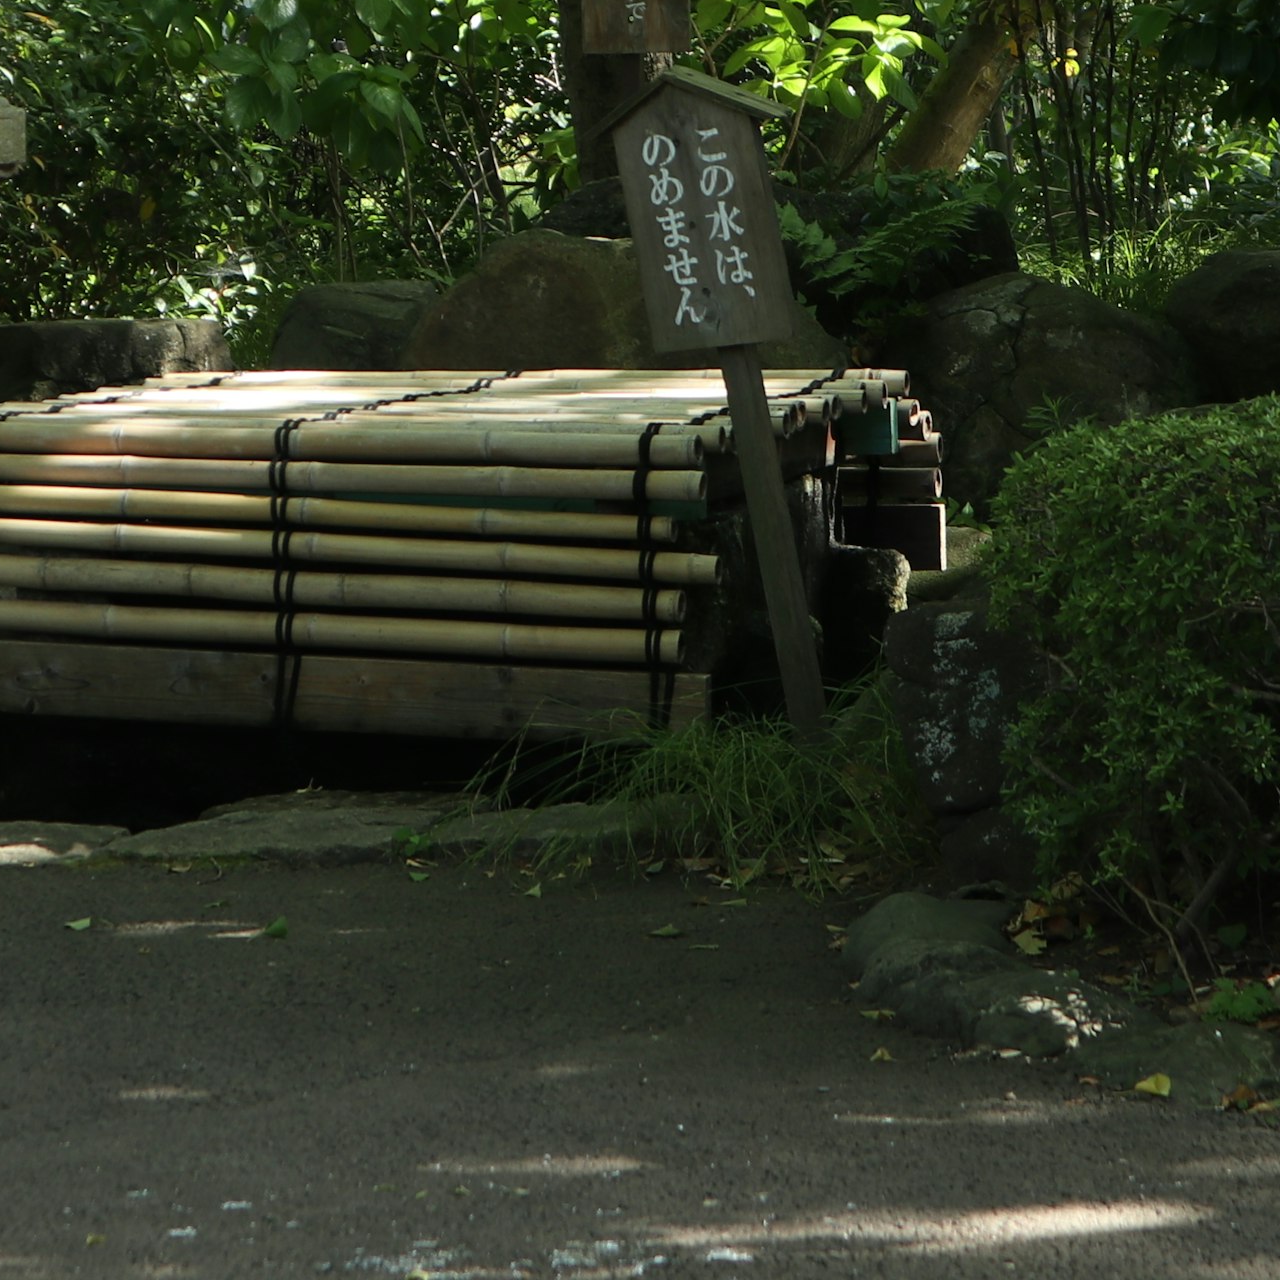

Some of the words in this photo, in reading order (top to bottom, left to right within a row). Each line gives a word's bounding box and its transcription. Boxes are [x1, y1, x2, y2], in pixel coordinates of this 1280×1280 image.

[641, 133, 707, 326] のめません
[694, 127, 756, 298] この水は、
